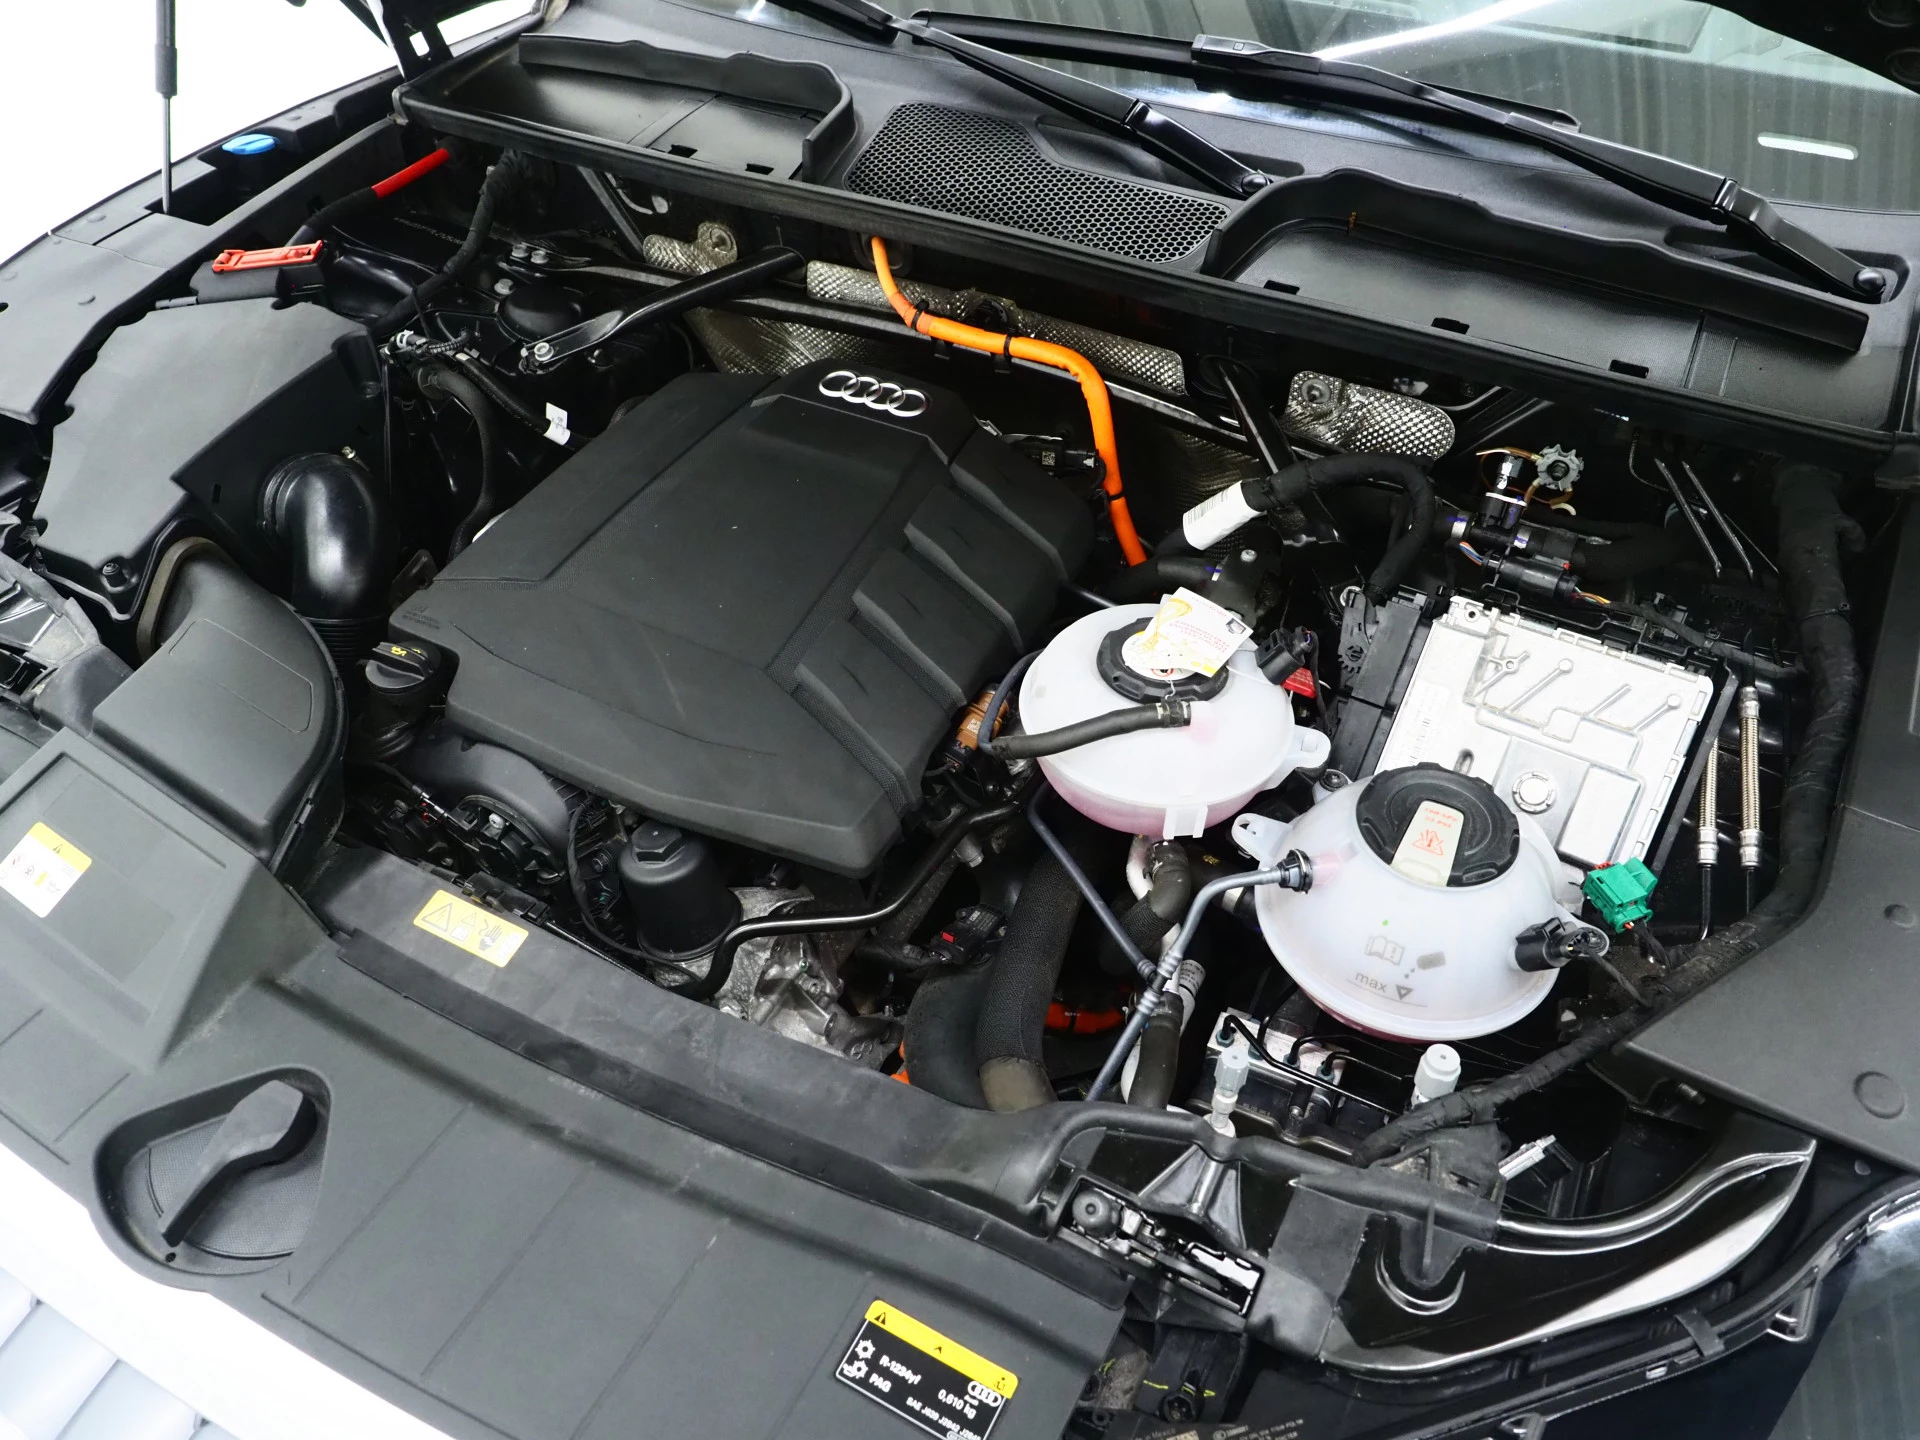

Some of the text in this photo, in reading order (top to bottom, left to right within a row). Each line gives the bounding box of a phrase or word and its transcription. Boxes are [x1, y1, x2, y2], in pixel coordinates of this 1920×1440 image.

[1354, 971, 1388, 993] max
[869, 1373, 892, 1393] PAG
[906, 1397, 923, 1412] SAE
[879, 1354, 922, 1386] R-1234yf
[963, 1402, 978, 1420] kg
